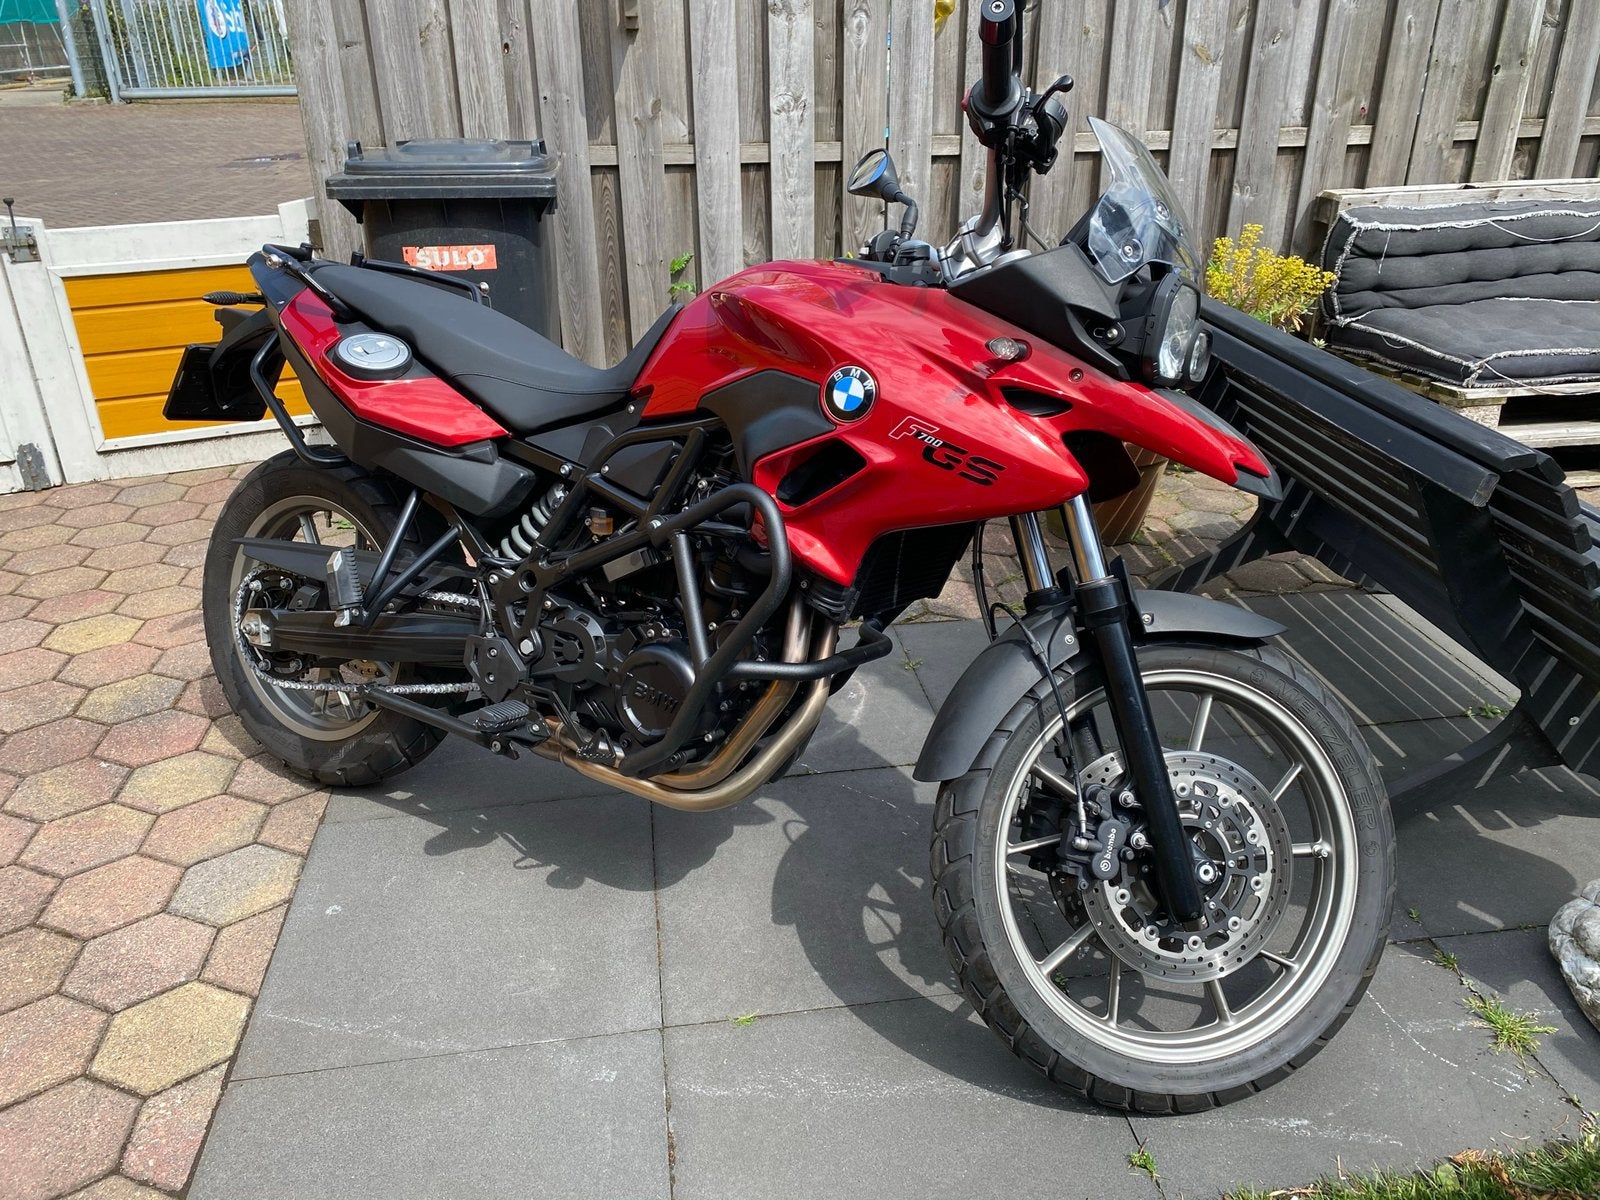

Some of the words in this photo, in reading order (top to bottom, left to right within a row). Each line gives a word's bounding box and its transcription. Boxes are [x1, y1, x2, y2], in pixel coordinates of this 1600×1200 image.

[415, 247, 485, 267] SULO
[833, 367, 874, 391] BMW
[888, 415, 940, 440] F
[917, 432, 944, 448] 700
[921, 441, 1008, 487] GS
[633, 679, 679, 714] BMW
[1275, 677, 1378, 831] METZELER
[1103, 827, 1117, 860] brembo
